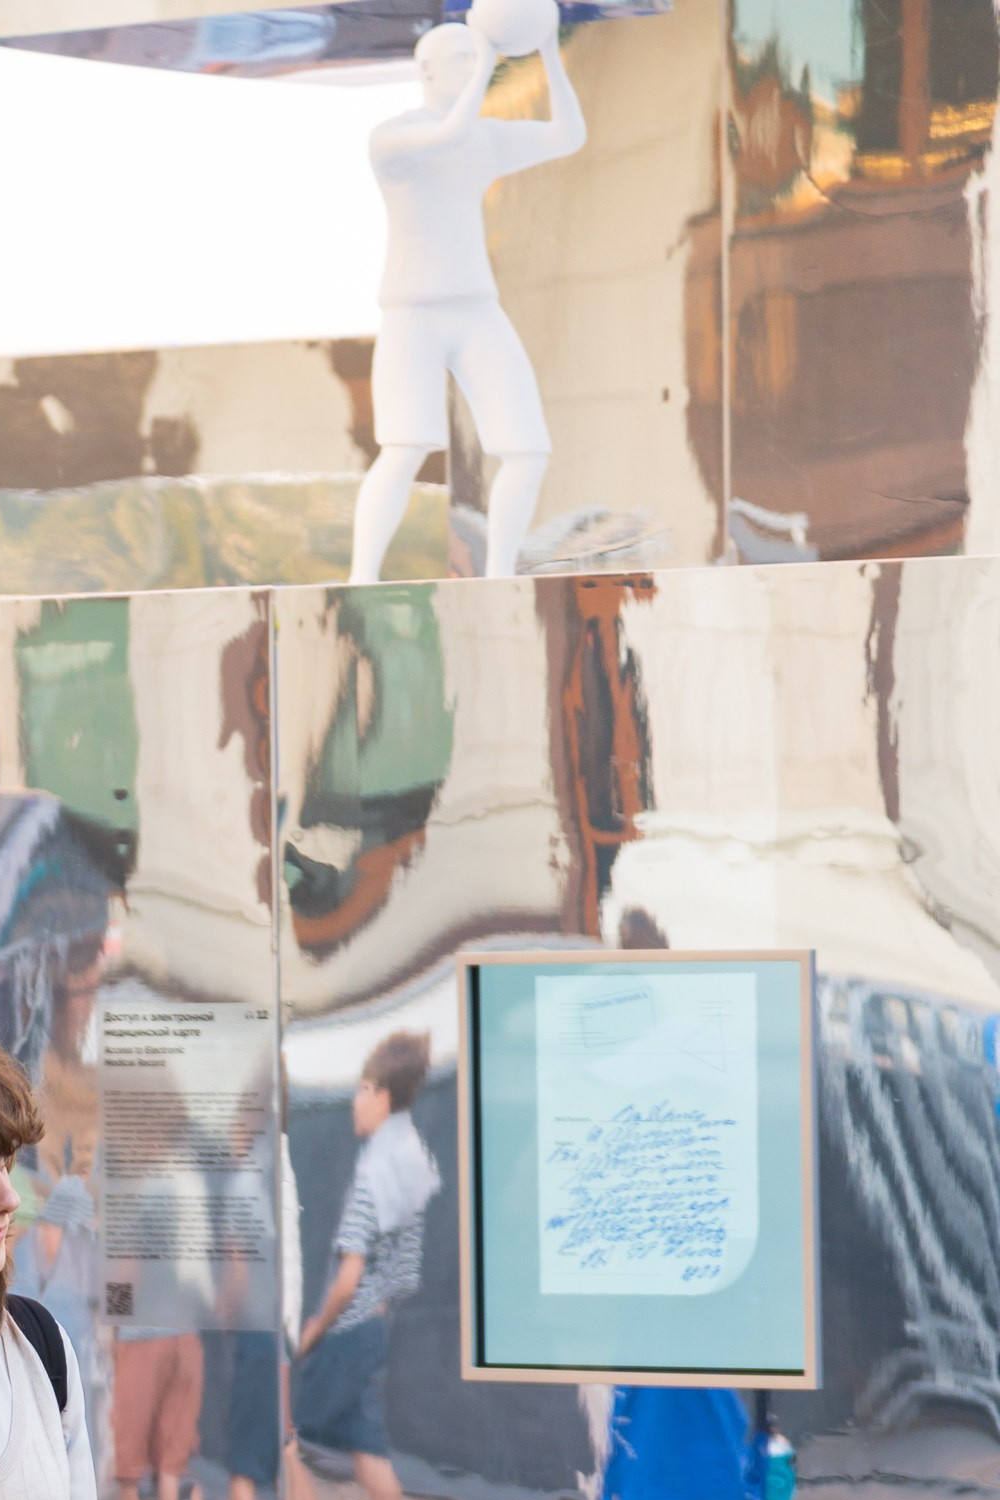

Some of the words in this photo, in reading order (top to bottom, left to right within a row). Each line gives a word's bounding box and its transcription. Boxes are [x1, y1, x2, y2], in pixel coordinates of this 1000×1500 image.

[104, 1011, 140, 1024] Доступ
[150, 1011, 215, 1024] электронной
[172, 1028, 201, 1039] карте
